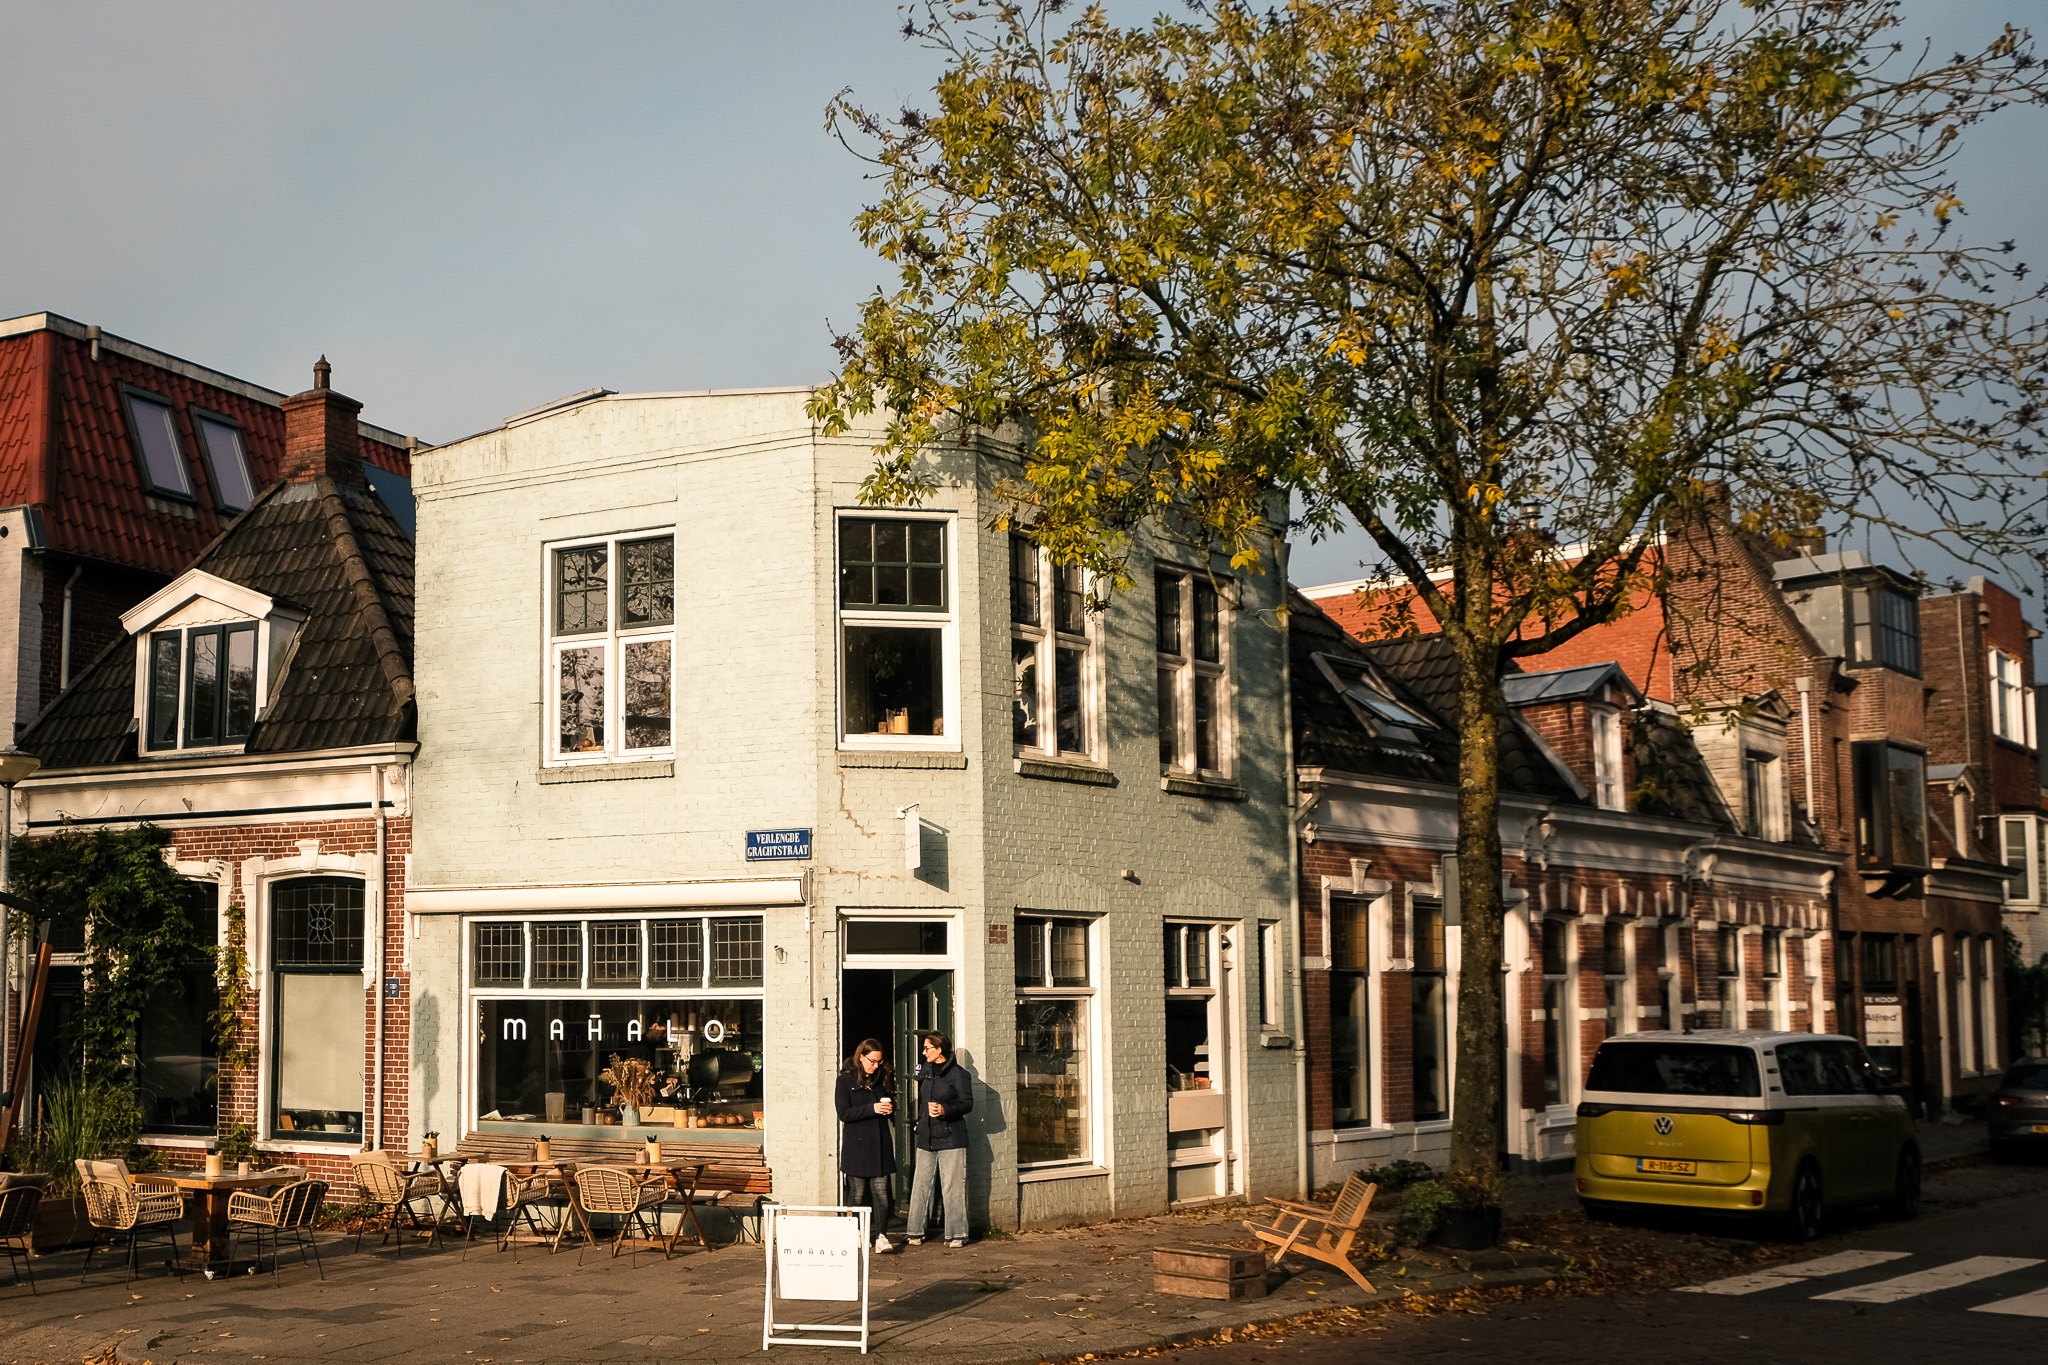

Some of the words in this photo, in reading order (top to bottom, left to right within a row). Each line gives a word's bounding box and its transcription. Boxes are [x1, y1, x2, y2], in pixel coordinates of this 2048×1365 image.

[756, 832, 800, 844] VERLENGDE
[747, 845, 808, 857] GRACHTSTRAAT
[822, 997, 830, 1010] 1
[1648, 1160, 1690, 1172] R-116-SZ
